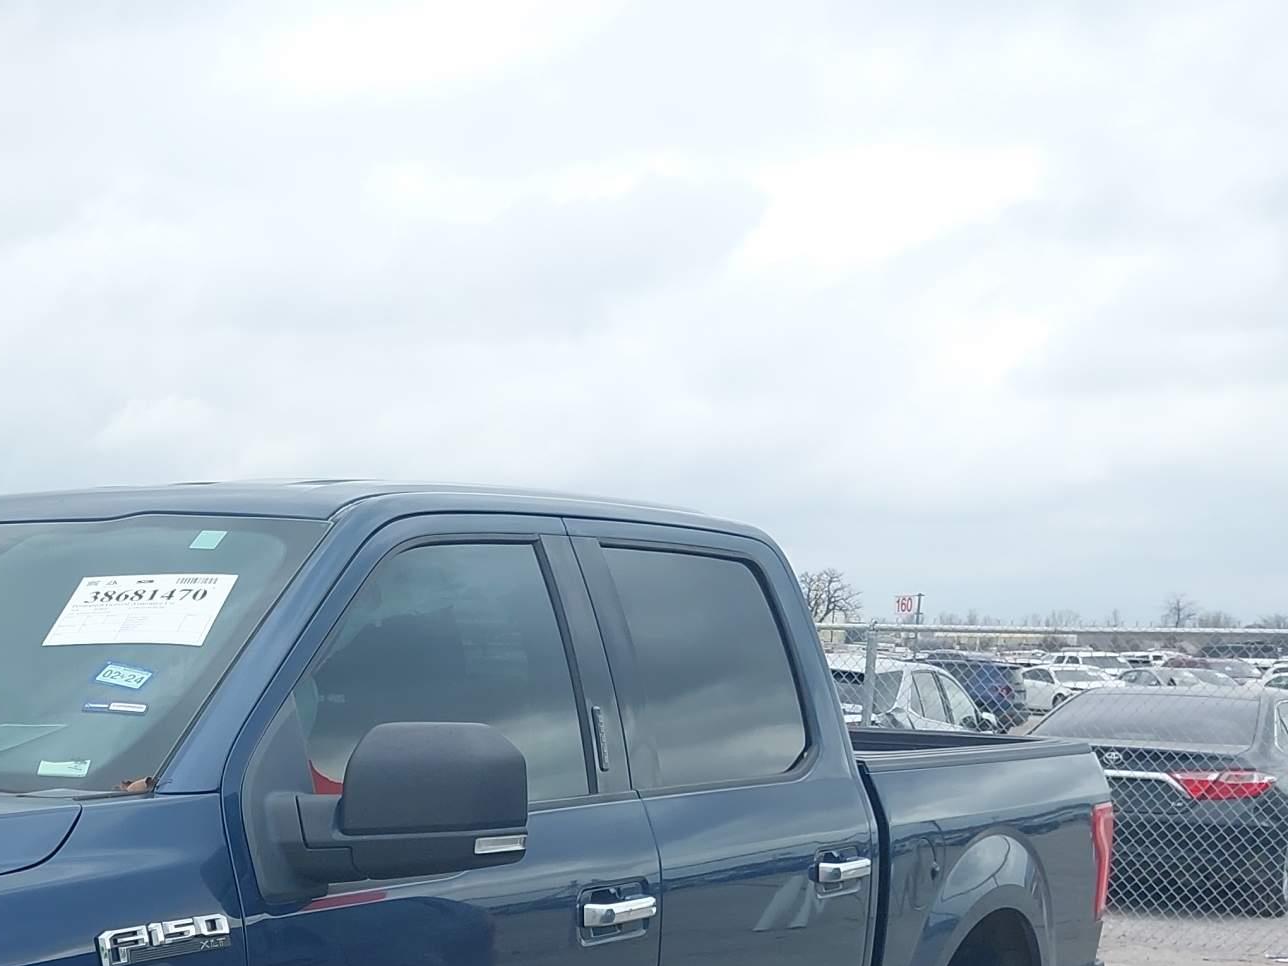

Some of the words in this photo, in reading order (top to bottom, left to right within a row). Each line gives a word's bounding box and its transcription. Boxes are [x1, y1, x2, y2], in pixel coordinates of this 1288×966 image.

[83, 588, 208, 604] 38681470
[896, 597, 913, 613] 160
[200, 937, 227, 951] XLT
